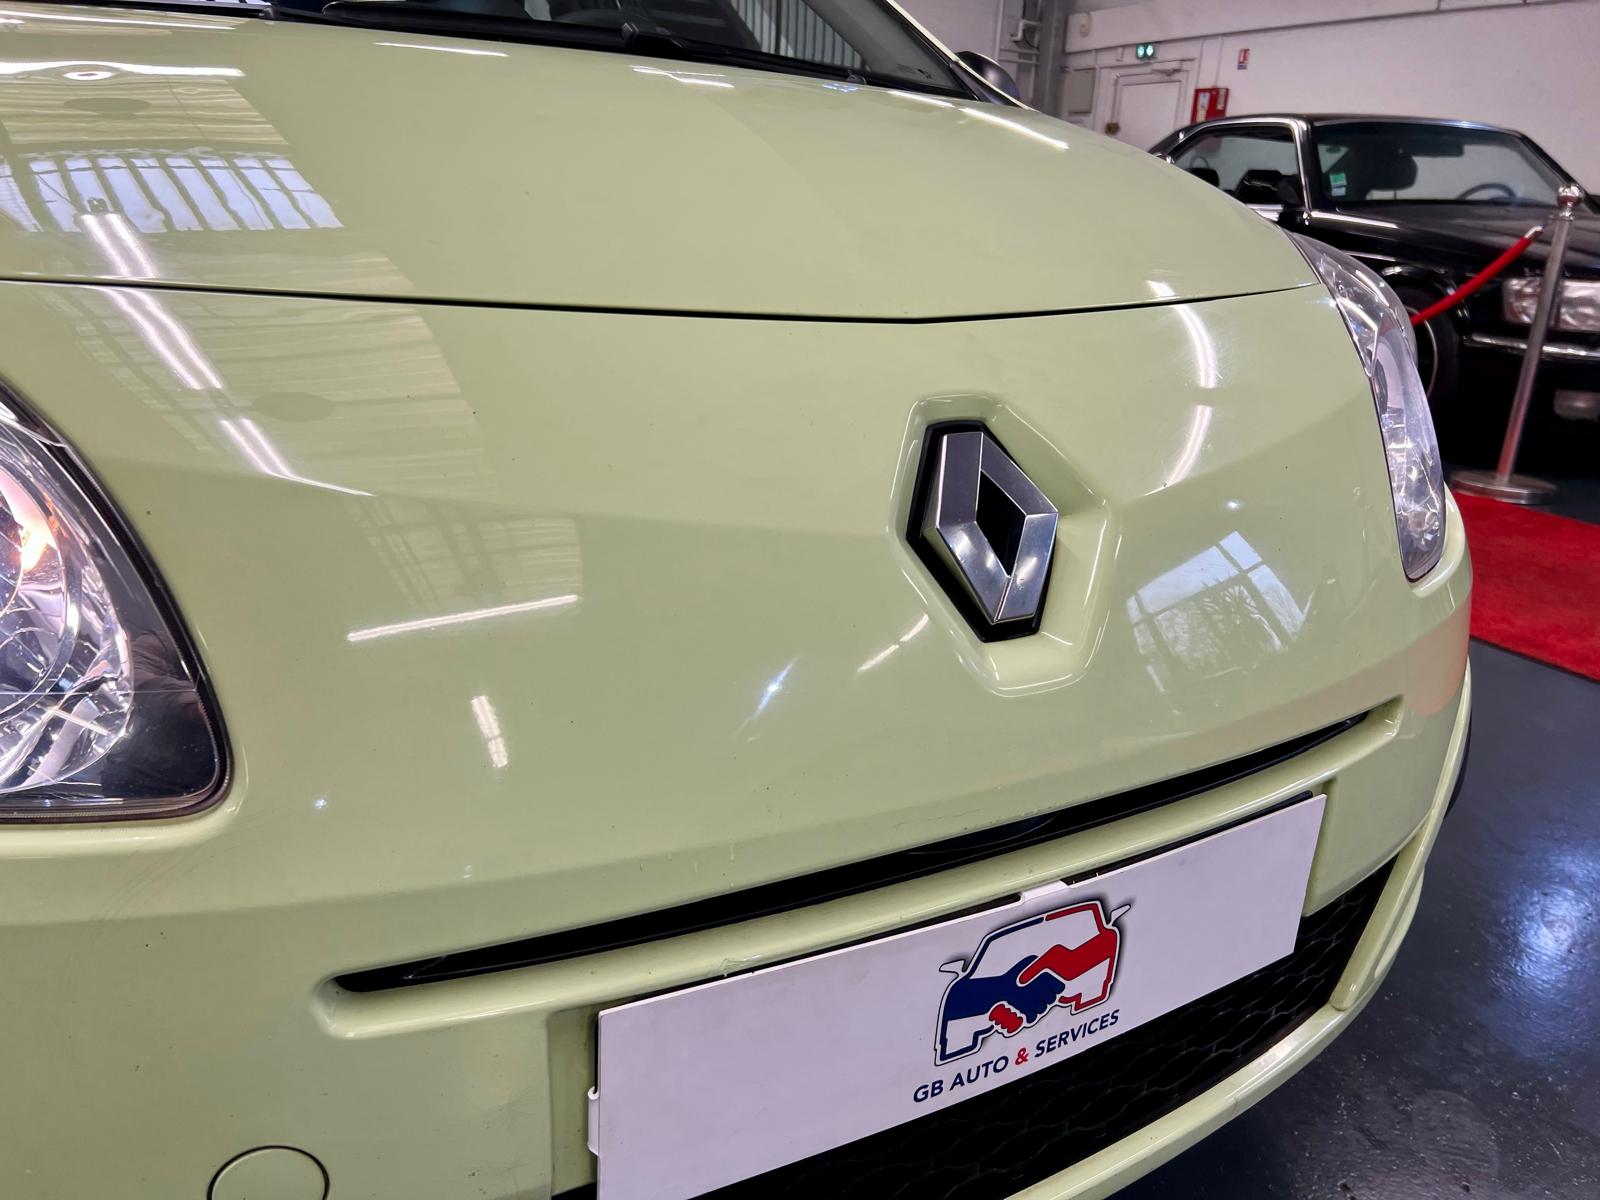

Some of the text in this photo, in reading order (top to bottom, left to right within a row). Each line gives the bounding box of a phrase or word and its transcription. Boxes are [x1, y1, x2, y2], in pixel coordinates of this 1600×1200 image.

[913, 1009, 1120, 1103] GB AUTO & SERVICES
